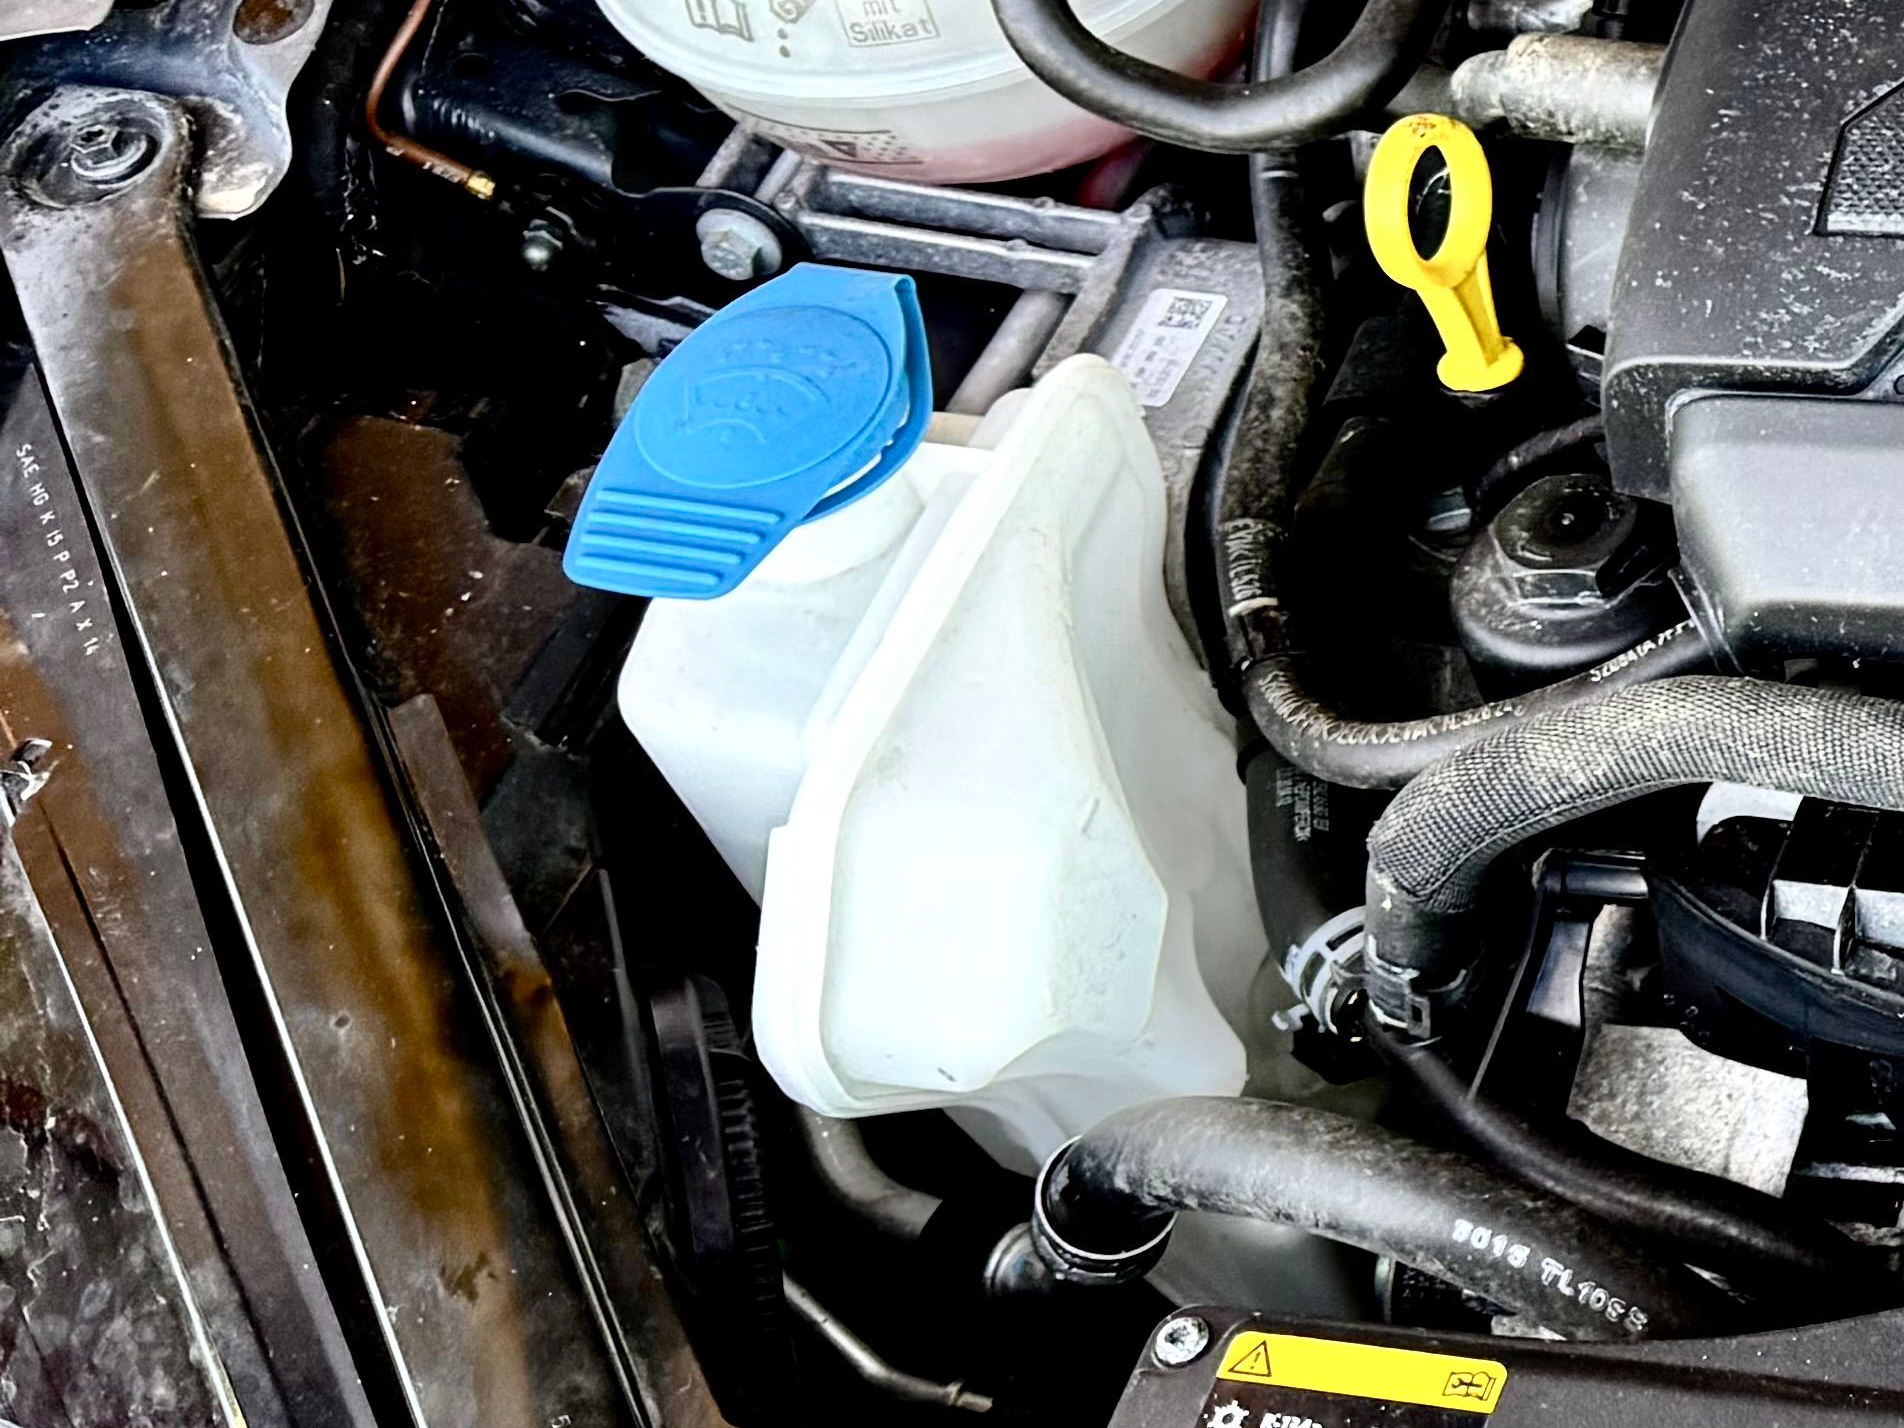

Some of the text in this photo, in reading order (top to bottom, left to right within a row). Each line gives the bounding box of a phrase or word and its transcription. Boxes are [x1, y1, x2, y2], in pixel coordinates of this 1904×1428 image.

[852, 18, 932, 43] Silikat
[16, 443, 40, 479] SAE
[29, 482, 50, 506] HG
[40, 510, 55, 525] K
[53, 550, 70, 562] P
[60, 569, 80, 594] P2
[69, 600, 85, 614] A
[76, 618, 93, 631] X
